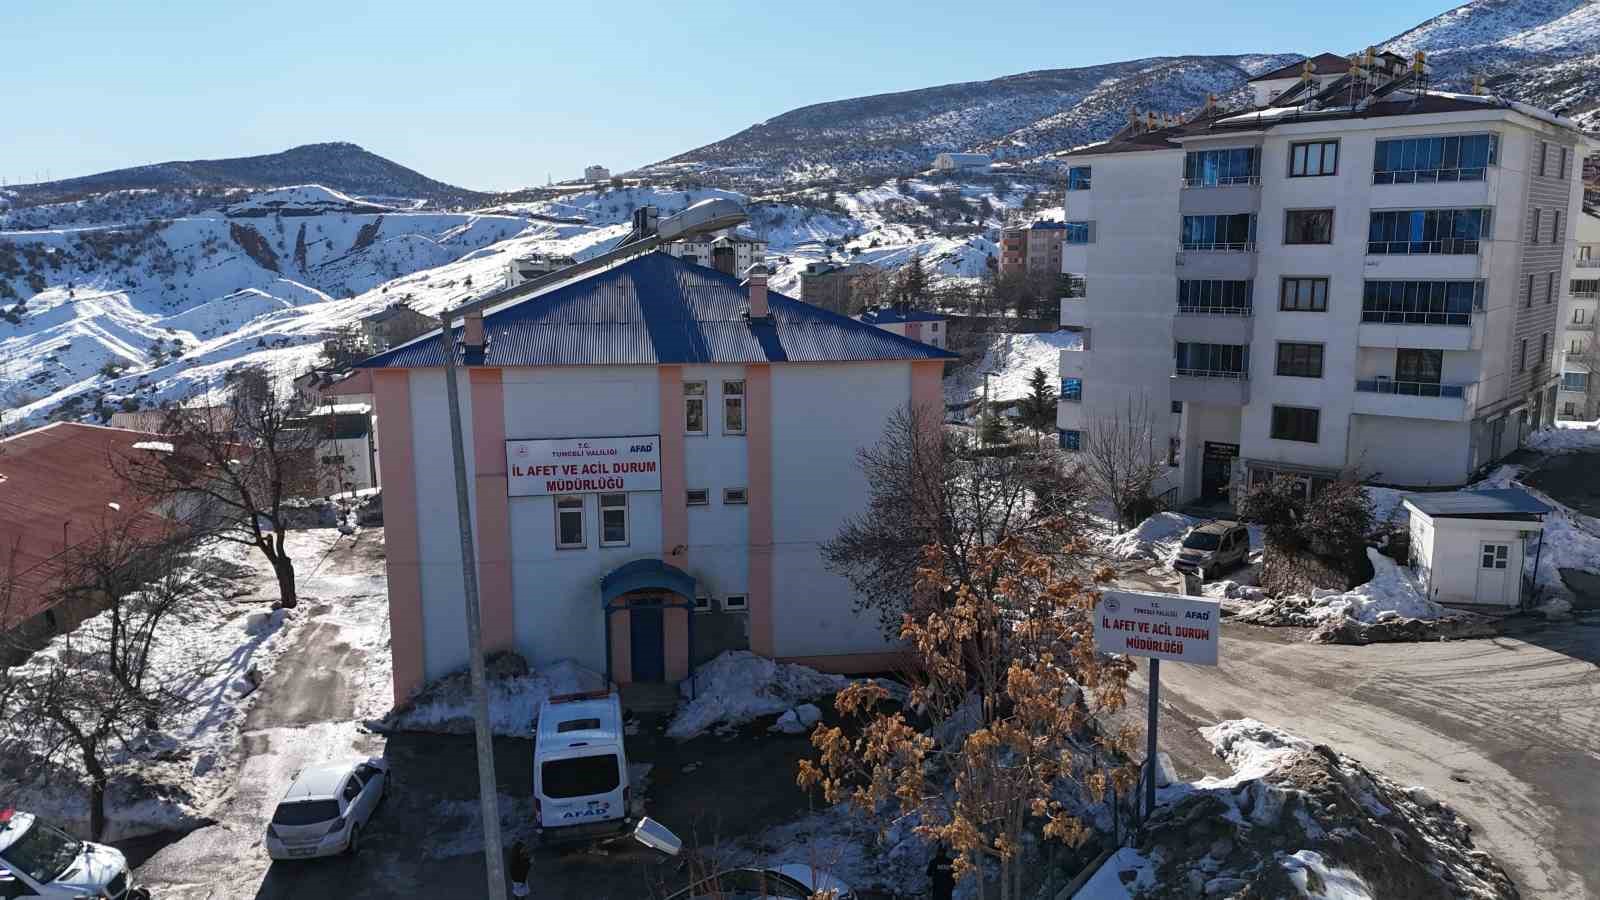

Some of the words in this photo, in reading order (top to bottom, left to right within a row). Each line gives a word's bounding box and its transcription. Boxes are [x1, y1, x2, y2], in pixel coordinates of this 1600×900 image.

[630, 444, 652, 453] AFAD
[512, 464, 525, 477] İL
[527, 464, 558, 476] AFET
[562, 464, 578, 475] VE
[581, 461, 609, 474] ACİL
[613, 461, 656, 473] DURUM
[546, 476, 624, 491] MÜDÜRLÜĞÜ
[1185, 611, 1209, 620] AFAD
[1102, 615, 1110, 629] İL
[1112, 619, 1136, 631] AFET
[1138, 622, 1149, 633] VE
[1152, 621, 1172, 635] ACİL
[1175, 625, 1209, 640] DURUM
[1126, 636, 1184, 654] MÜDÜRLÜĞÜ
[563, 808, 607, 818] AFAD
